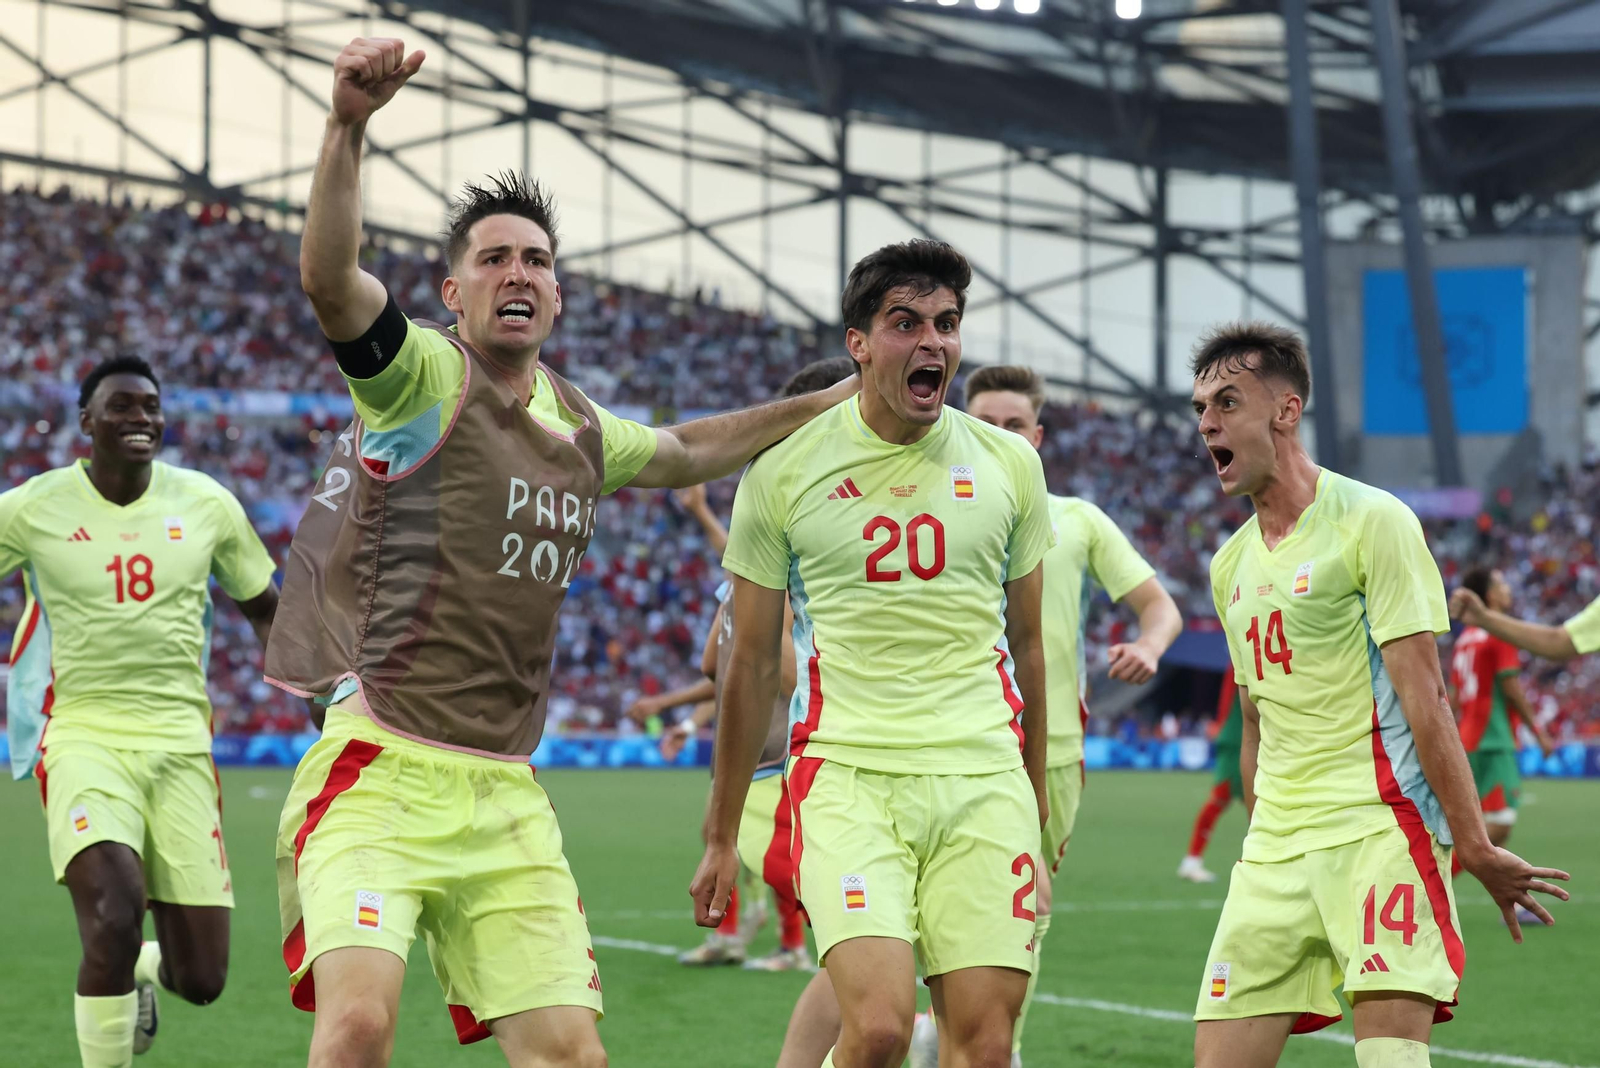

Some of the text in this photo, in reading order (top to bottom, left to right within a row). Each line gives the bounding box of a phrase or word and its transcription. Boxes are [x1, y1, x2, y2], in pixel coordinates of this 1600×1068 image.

[105, 553, 155, 604] 18
[862, 512, 945, 583] 20
[1245, 609, 1293, 681] 14
[1361, 883, 1419, 946] 14
